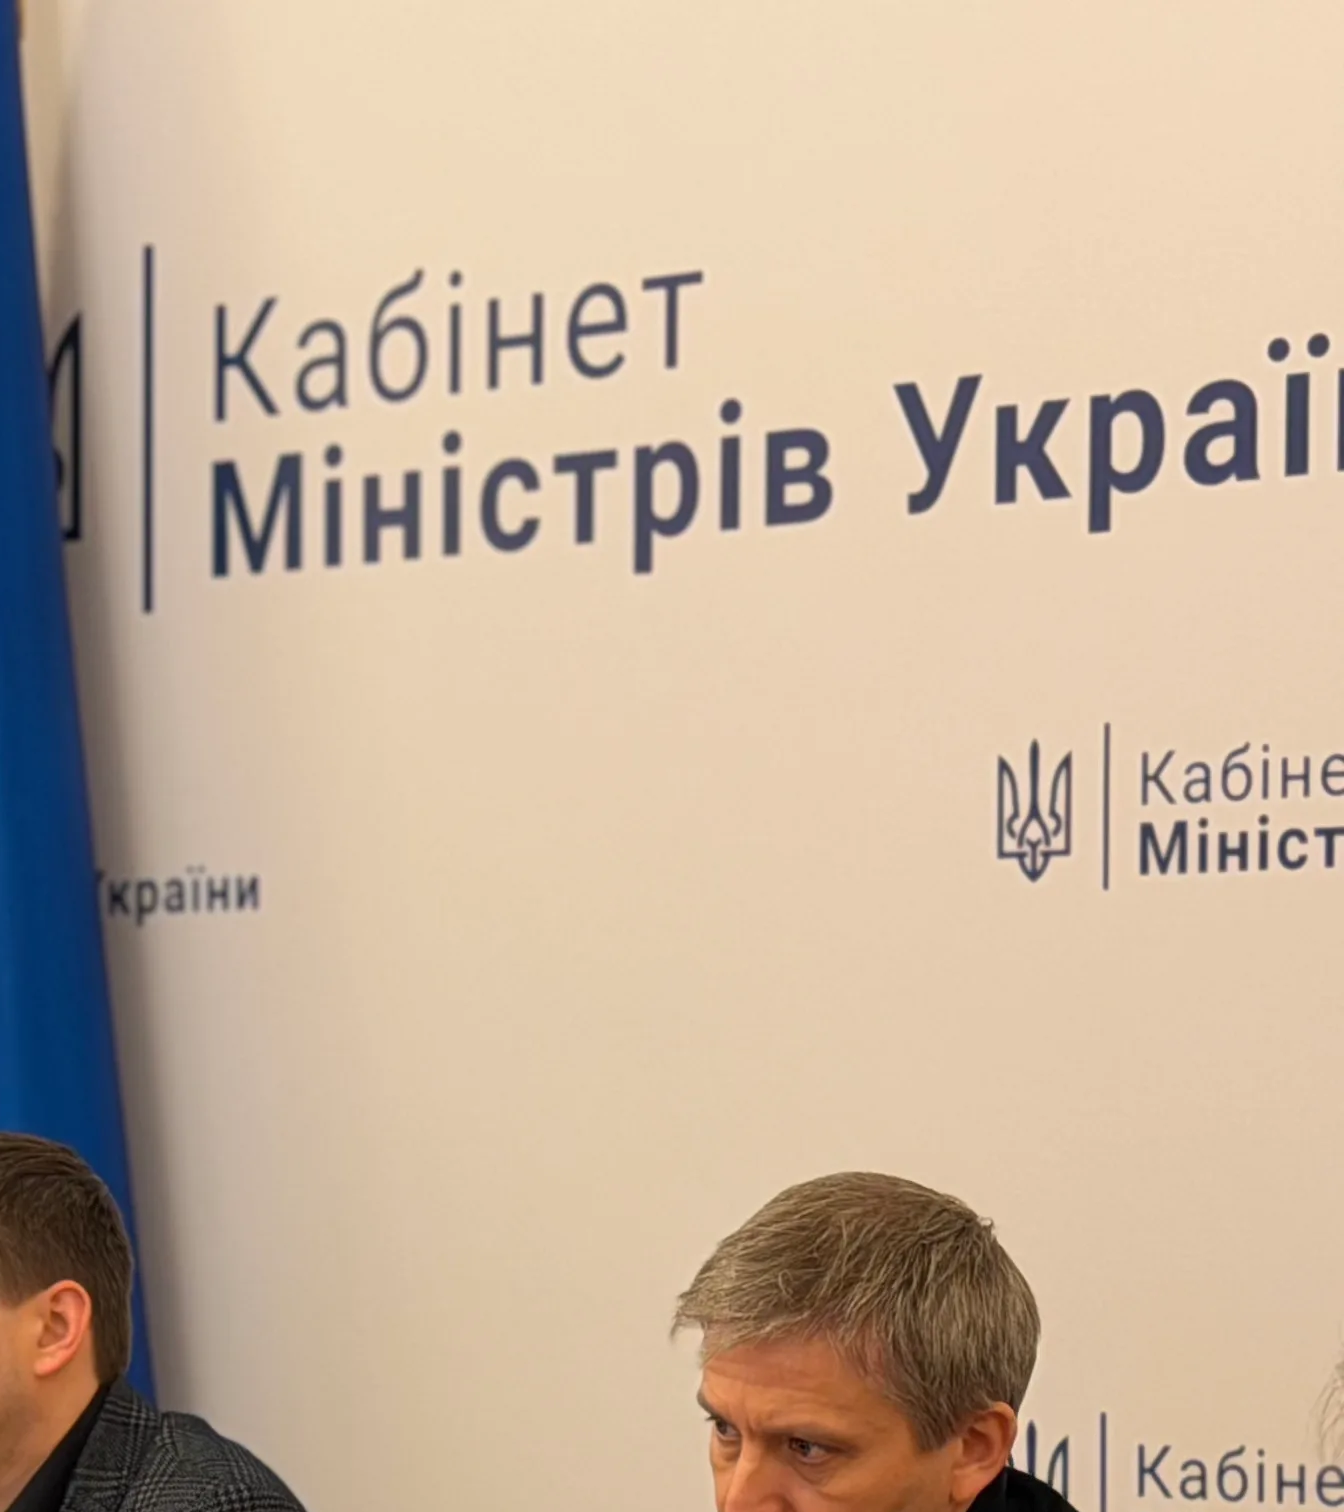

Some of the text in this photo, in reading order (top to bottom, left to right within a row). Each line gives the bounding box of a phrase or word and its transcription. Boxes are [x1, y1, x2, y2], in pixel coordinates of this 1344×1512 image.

[212, 269, 706, 423] Кабінет
[210, 333, 1344, 580] Міністрів Украї
[1139, 742, 1344, 806] Кабіне
[1138, 814, 1344, 876] Мініст
[96, 864, 260, 927] країни
[1137, 1444, 1344, 1506] Кабіне
